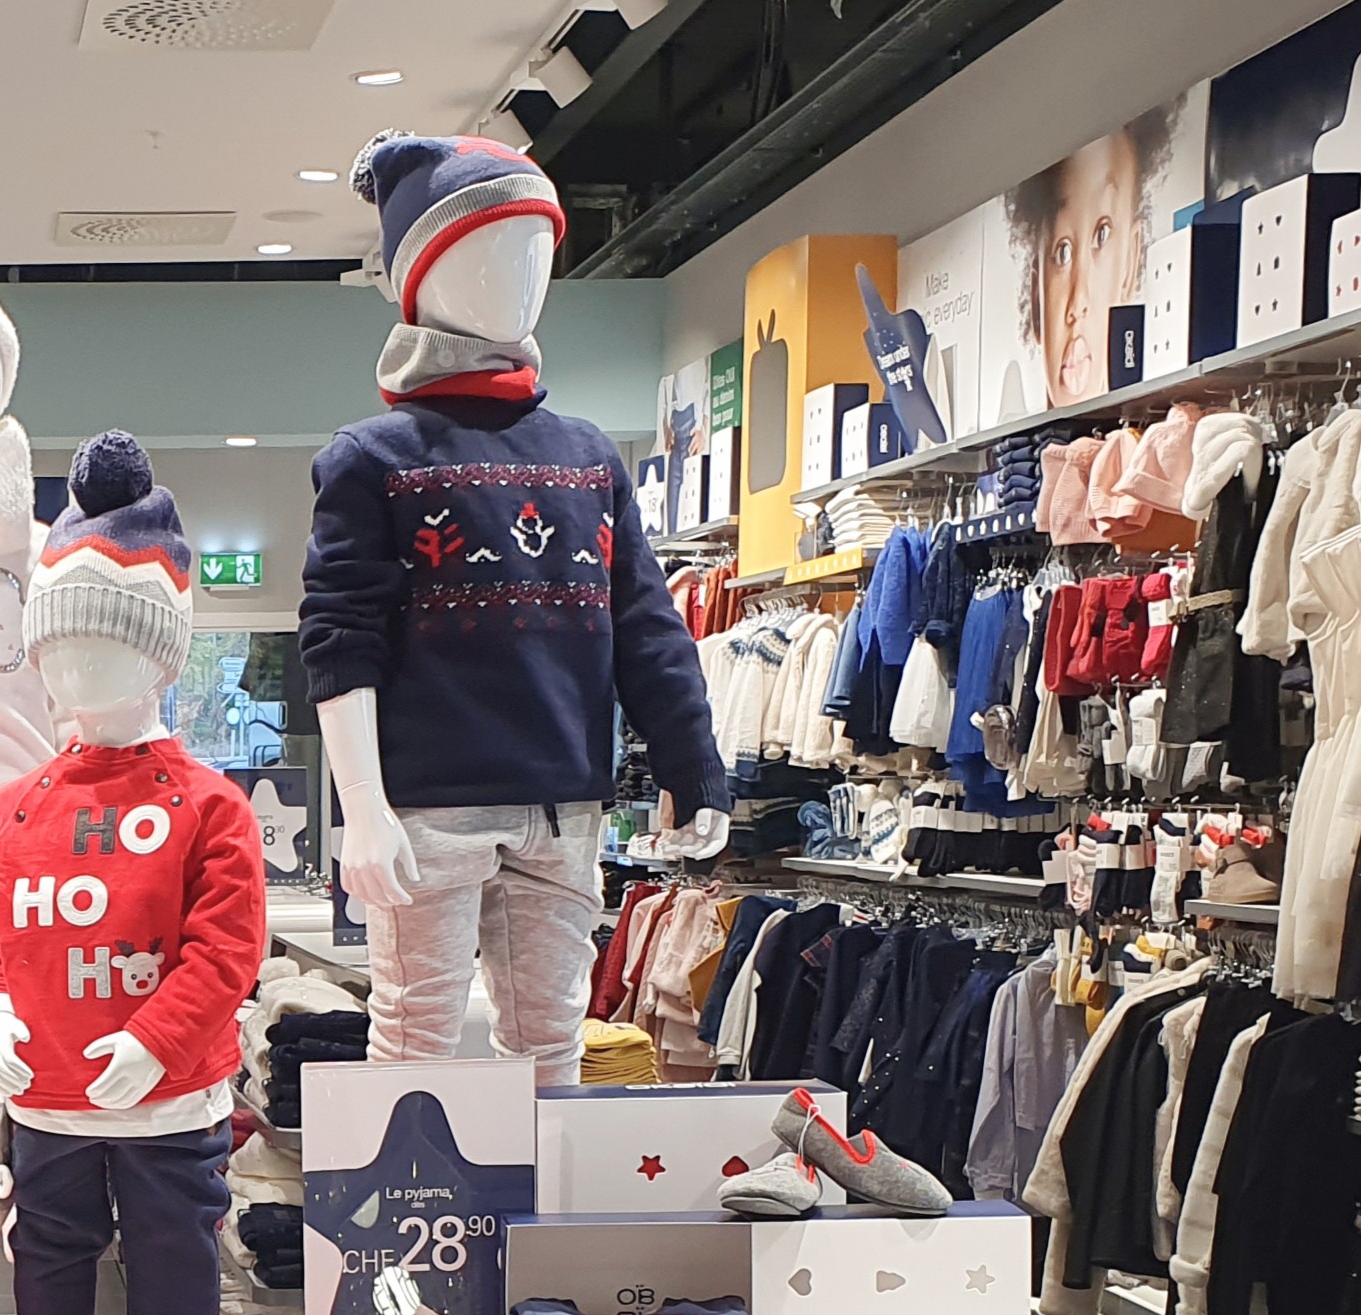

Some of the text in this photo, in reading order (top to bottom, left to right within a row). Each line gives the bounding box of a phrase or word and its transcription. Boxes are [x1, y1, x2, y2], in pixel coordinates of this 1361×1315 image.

[72, 804, 171, 855] HO
[12, 874, 109, 929] HO
[386, 1187, 401, 1199] Le
[397, 1215, 468, 1272] 28
